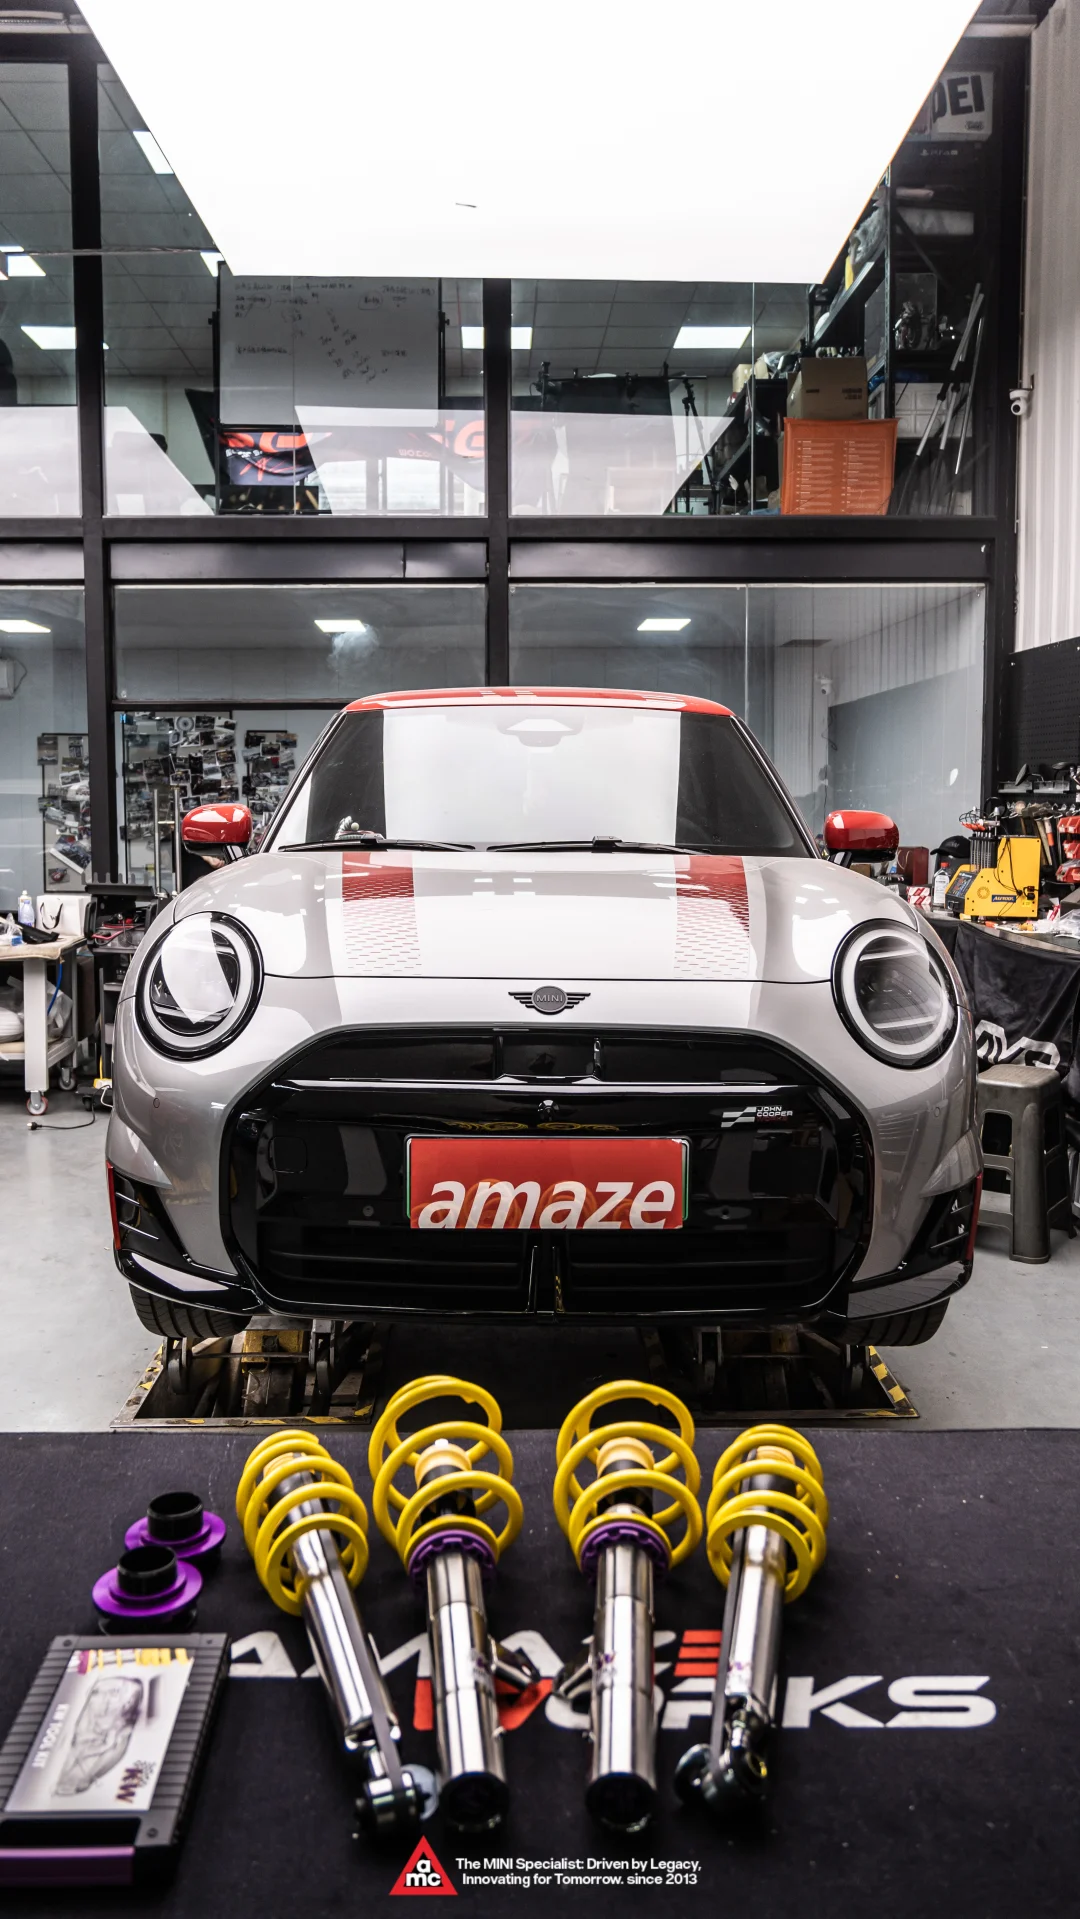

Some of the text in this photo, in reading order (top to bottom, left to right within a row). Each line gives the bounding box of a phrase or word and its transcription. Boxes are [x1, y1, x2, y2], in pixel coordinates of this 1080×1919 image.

[536, 994, 563, 1002] MINI
[418, 1180, 676, 1229] amaze
[115, 1767, 144, 1804] KW
